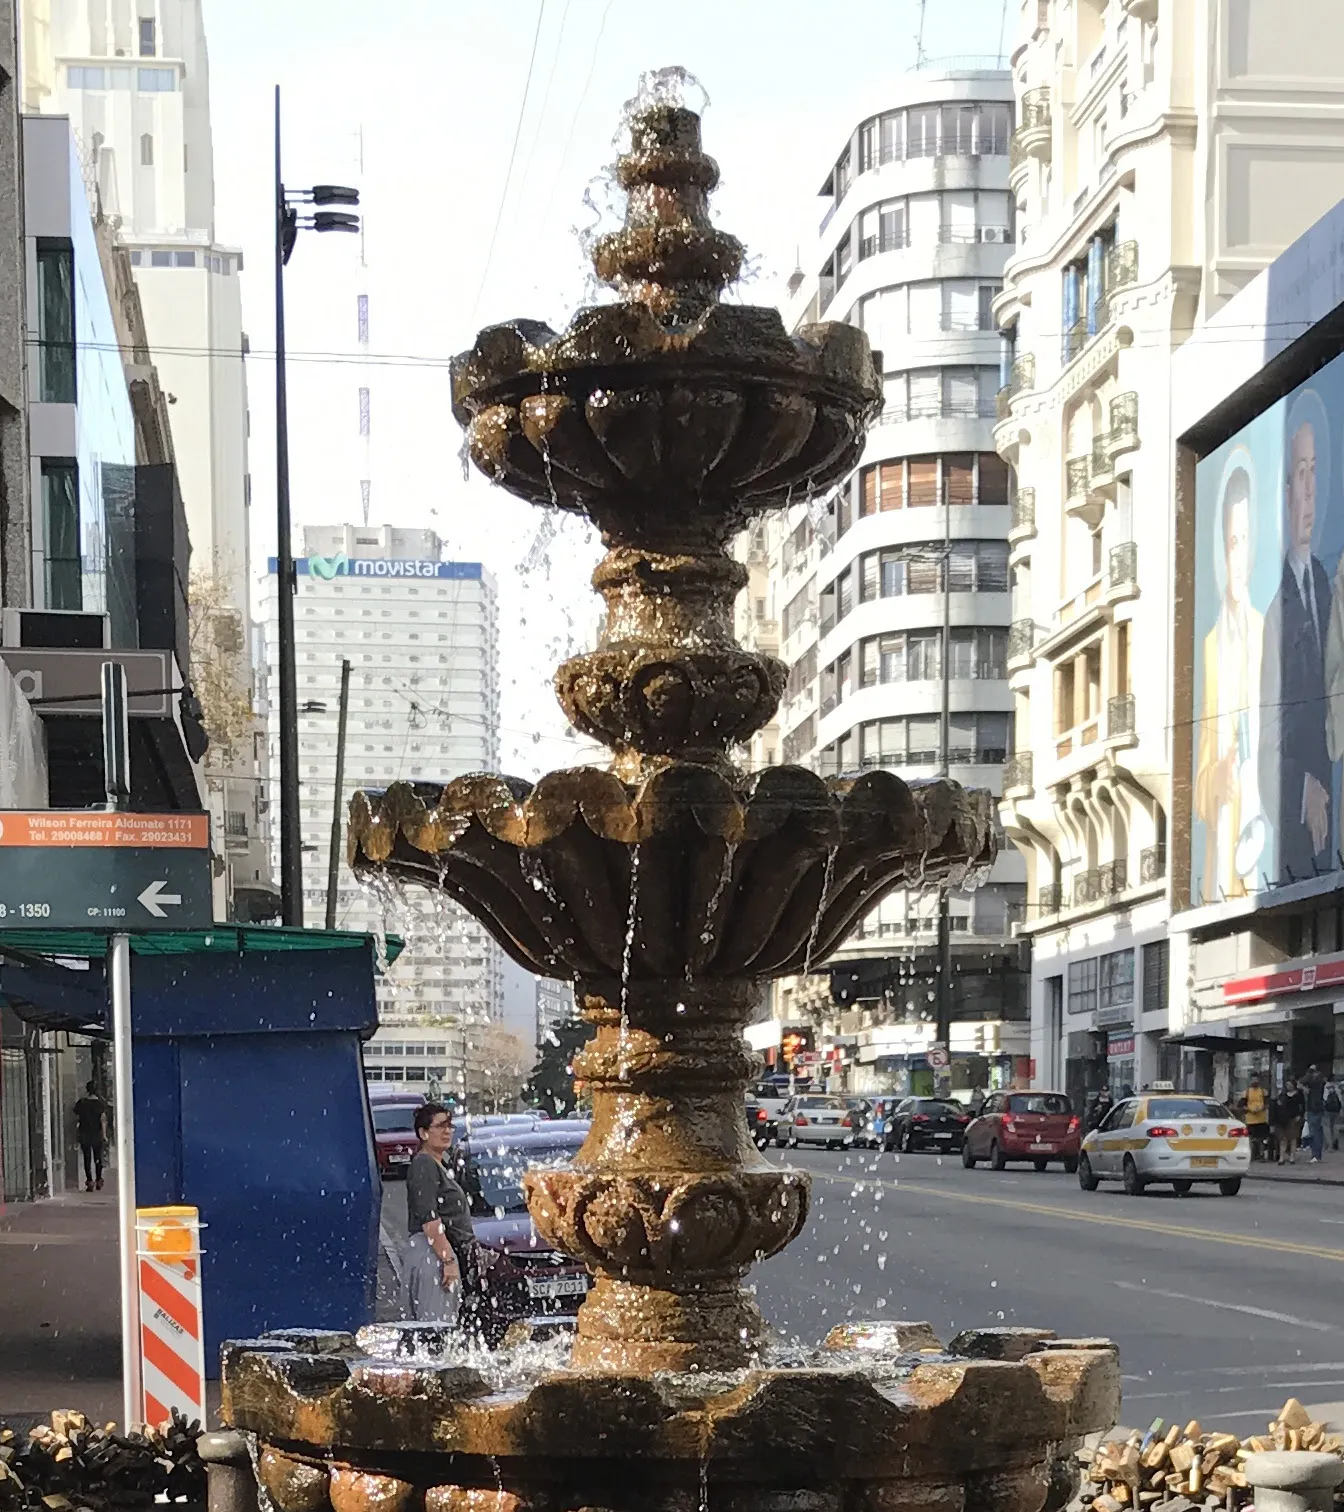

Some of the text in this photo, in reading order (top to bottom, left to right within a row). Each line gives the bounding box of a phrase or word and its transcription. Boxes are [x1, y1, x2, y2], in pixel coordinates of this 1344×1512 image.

[355, 560, 441, 577] movistar
[28, 817, 193, 830] Wilson Ferreira Aldunate 1171
[29, 831, 48, 841] Tel.
[115, 832, 137, 842] Fax.
[141, 832, 193, 842] 29023431
[19, 904, 51, 917] 1350
